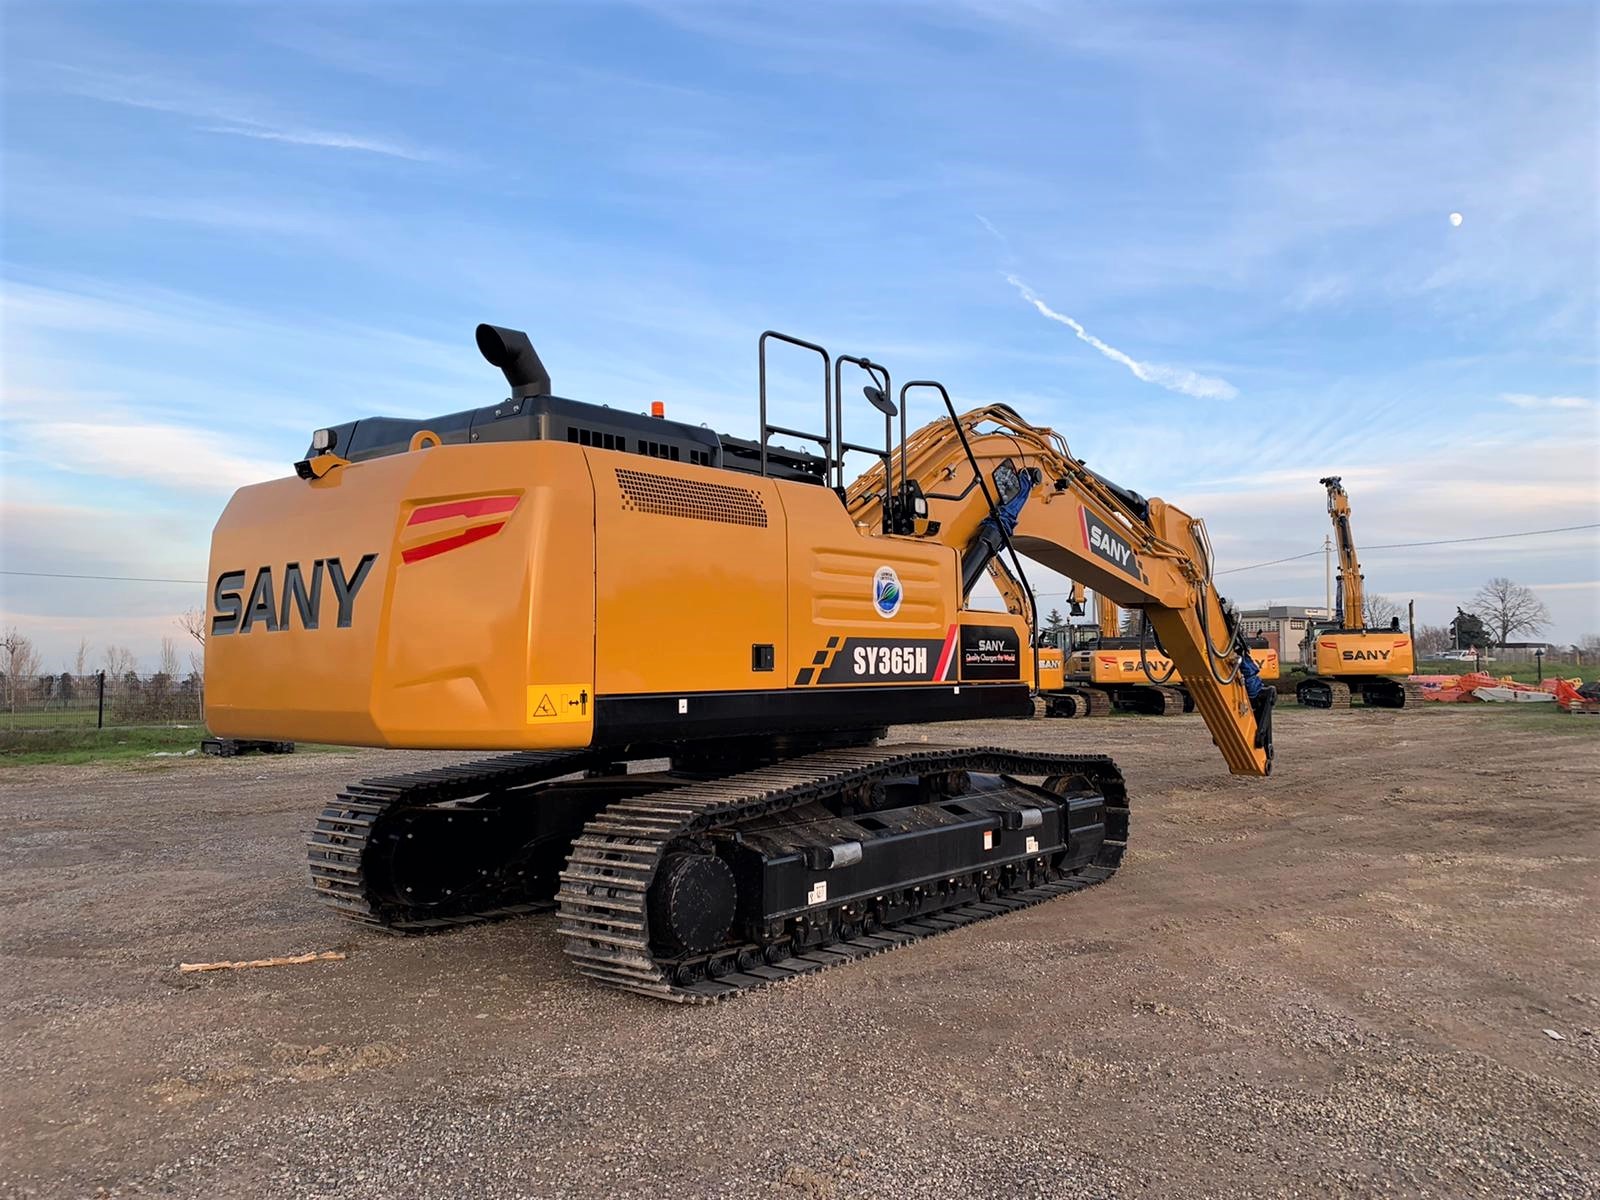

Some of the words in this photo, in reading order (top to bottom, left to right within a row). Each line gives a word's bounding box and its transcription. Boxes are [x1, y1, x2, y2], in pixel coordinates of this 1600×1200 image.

[1090, 525, 1131, 567] SANY
[211, 553, 379, 636] SANY
[978, 640, 1005, 651] SANY
[1342, 649, 1390, 661] SANY
[853, 646, 927, 675] SY365H
[1038, 660, 1061, 669] SANY
